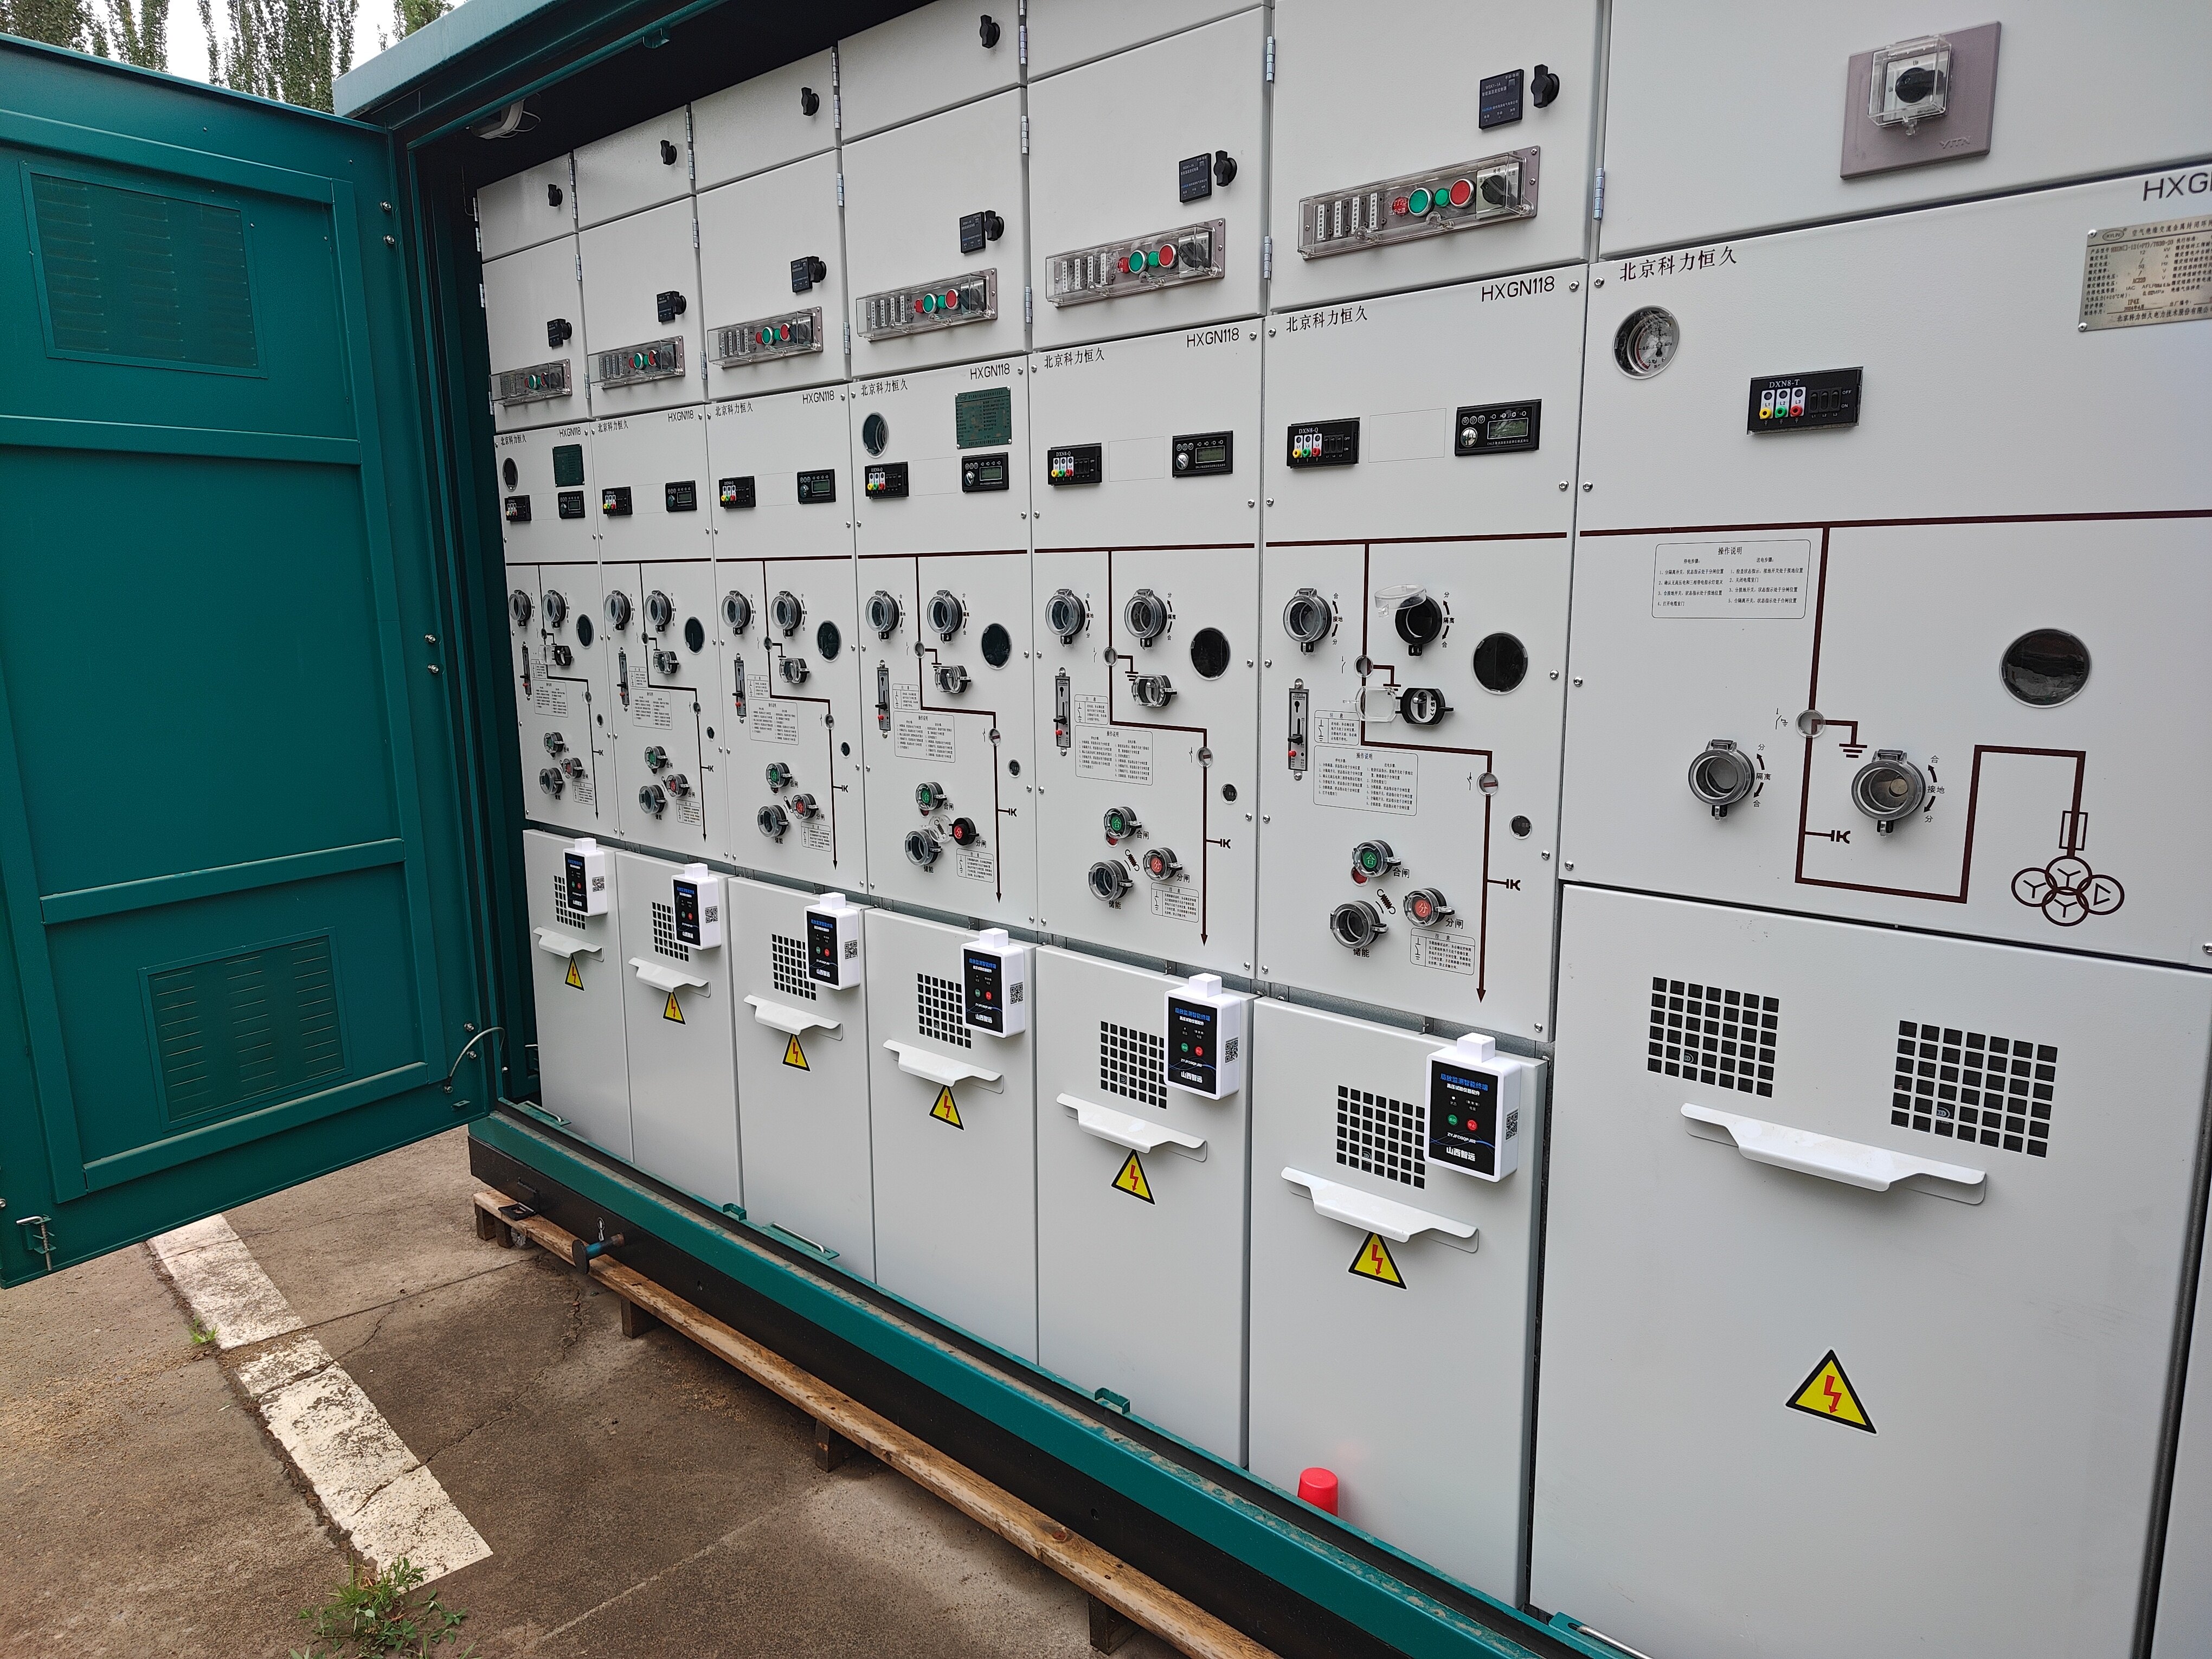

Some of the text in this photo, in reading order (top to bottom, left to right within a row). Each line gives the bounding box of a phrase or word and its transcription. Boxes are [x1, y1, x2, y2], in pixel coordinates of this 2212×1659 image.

[2143, 172, 2212, 201] HXG
[1620, 246, 1737, 282] 北京科力恒久
[1481, 275, 1555, 303] HXGN118
[1285, 305, 1368, 333] 北京科力恒久
[1187, 327, 1240, 348] HXGN118
[1044, 347, 1105, 369] 北京科力恒久
[969, 363, 1011, 380] HXGN118
[861, 378, 908, 397] 北京科力恒久
[1769, 379, 1800, 389] DXN8-T
[802, 390, 835, 404] HXGN118
[715, 401, 754, 417] 北京科力恒久
[667, 410, 694, 422] HXGN118
[597, 420, 629, 433] 北京科力恒久
[559, 427, 581, 438] HXGN118
[1718, 546, 1742, 555] 操作说明
[1930, 755, 1939, 764] 合
[1756, 772, 1771, 781] 隔离
[1927, 785, 1945, 795] 接地
[924, 793, 929, 802] 合
[943, 802, 954, 811] 合闸
[1752, 800, 1761, 808] 合
[1114, 819, 1121, 828] 合
[1924, 814, 1933, 823] 分
[956, 828, 962, 838] 分
[1136, 830, 1149, 840] 合闸
[975, 839, 987, 848] 分闸
[1153, 860, 1161, 869] 分
[1366, 854, 1375, 865] 合
[1176, 873, 1190, 883] 分闸
[1392, 867, 1410, 878] 合闸
[1108, 900, 1122, 909] 储能
[1418, 903, 1427, 914] 分
[1445, 918, 1463, 929] 分闸
[1353, 948, 1370, 957] 储能
[1181, 1071, 1203, 1083] 山西智远
[1440, 1073, 1488, 1091] 局放监测智能终端
[1446, 1146, 1476, 1161] 山西智远
